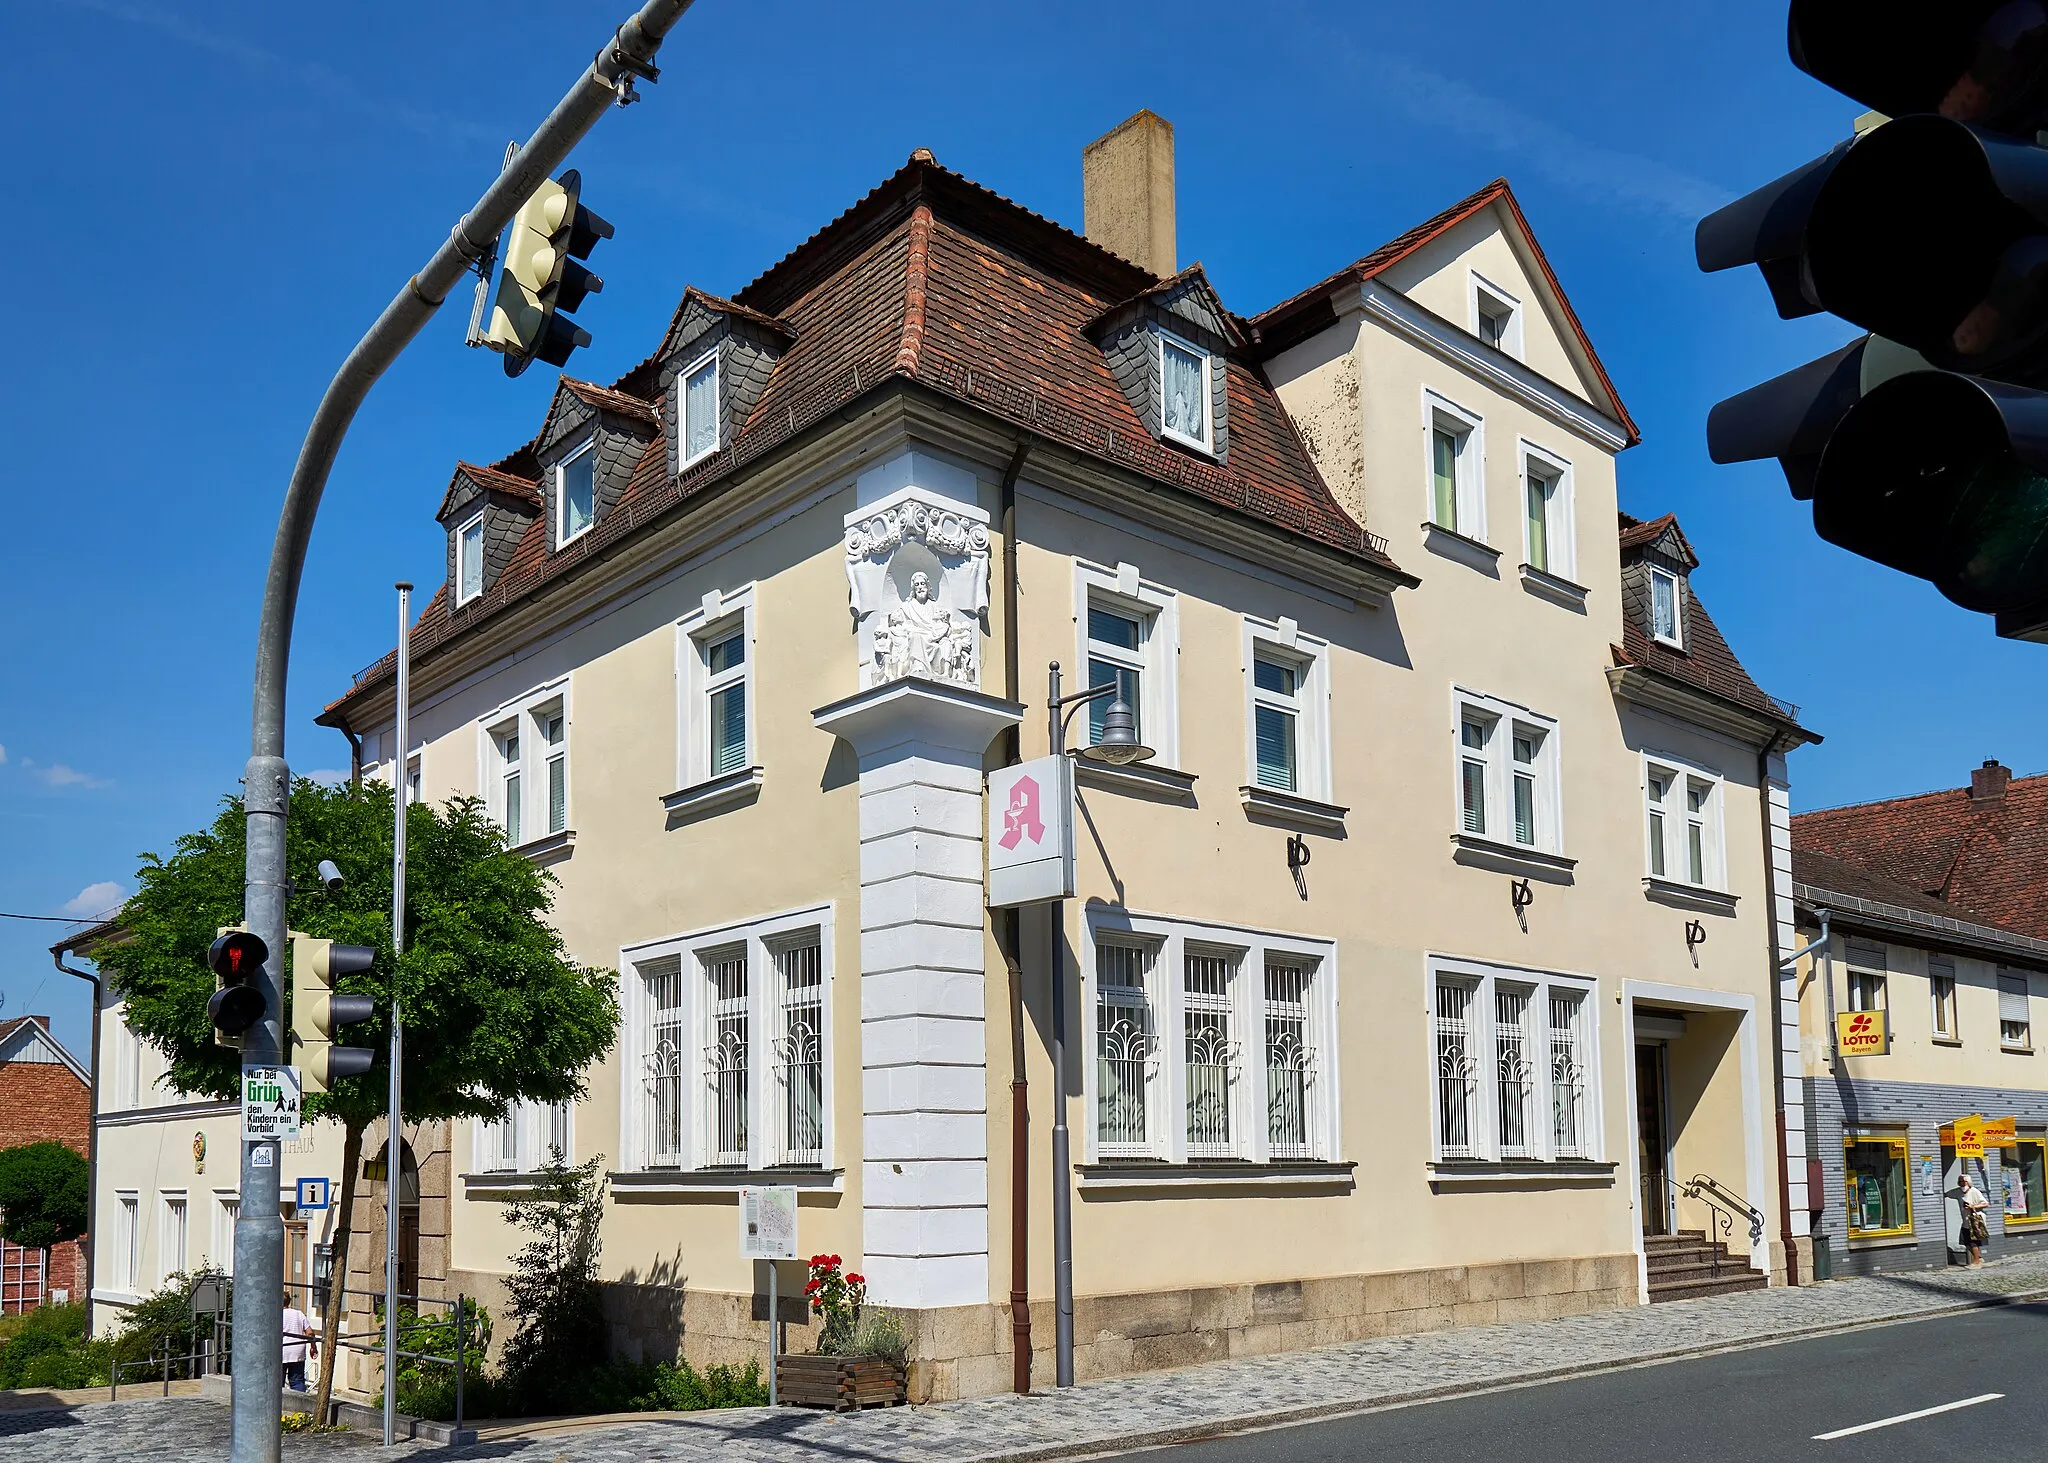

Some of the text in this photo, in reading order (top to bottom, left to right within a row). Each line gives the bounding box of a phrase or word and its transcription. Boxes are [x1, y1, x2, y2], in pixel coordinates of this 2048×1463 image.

[1843, 1035, 1879, 1045] LOTTO
[248, 1069, 277, 1079] Nur bei
[248, 1081, 282, 1102] Grün
[248, 1104, 262, 1114] den
[248, 1114, 291, 1123] Kindern ein
[248, 1124, 274, 1132] Vorbild
[282, 1137, 315, 1154] THAUS
